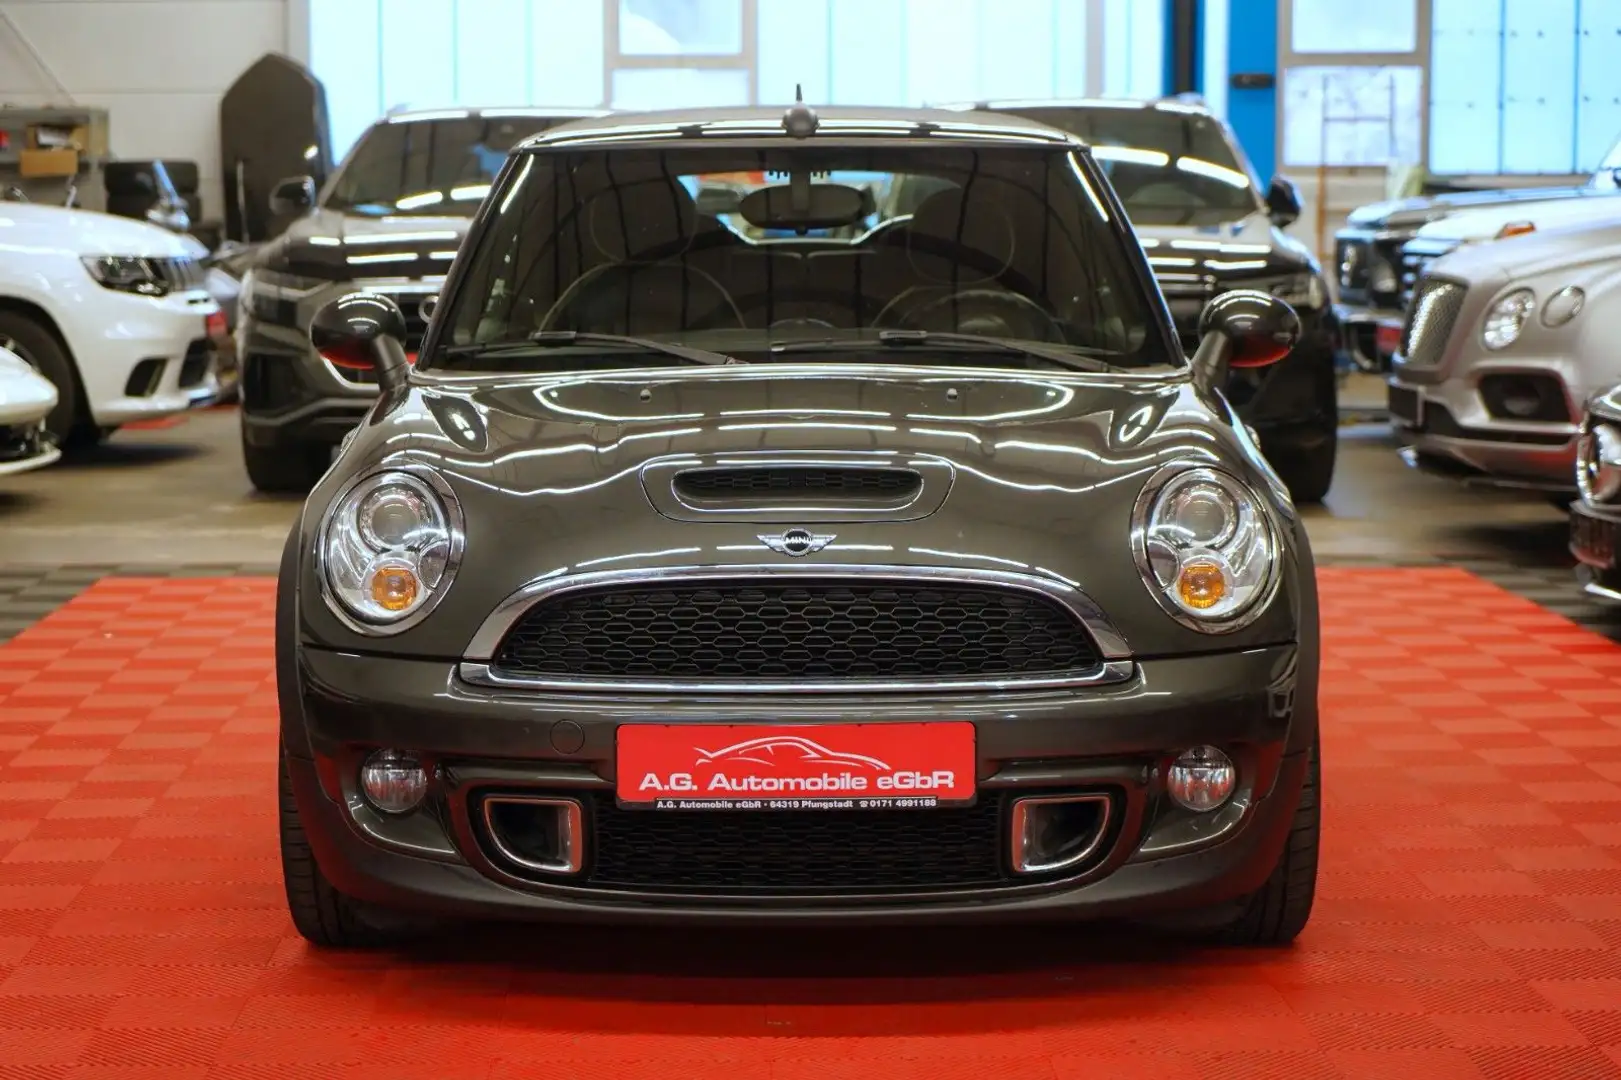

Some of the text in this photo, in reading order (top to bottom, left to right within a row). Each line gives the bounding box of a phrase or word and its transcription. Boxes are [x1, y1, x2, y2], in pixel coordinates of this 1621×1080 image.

[785, 536, 812, 544] MINI
[639, 770, 954, 791] A.G. Automobile eGbR
[657, 801, 677, 809] A.G.
[679, 801, 733, 809] Automobile
[735, 801, 762, 809] eGbR
[769, 800, 800, 809] 64319
[801, 800, 853, 810] Pfungstadt
[869, 799, 893, 808] 0171
